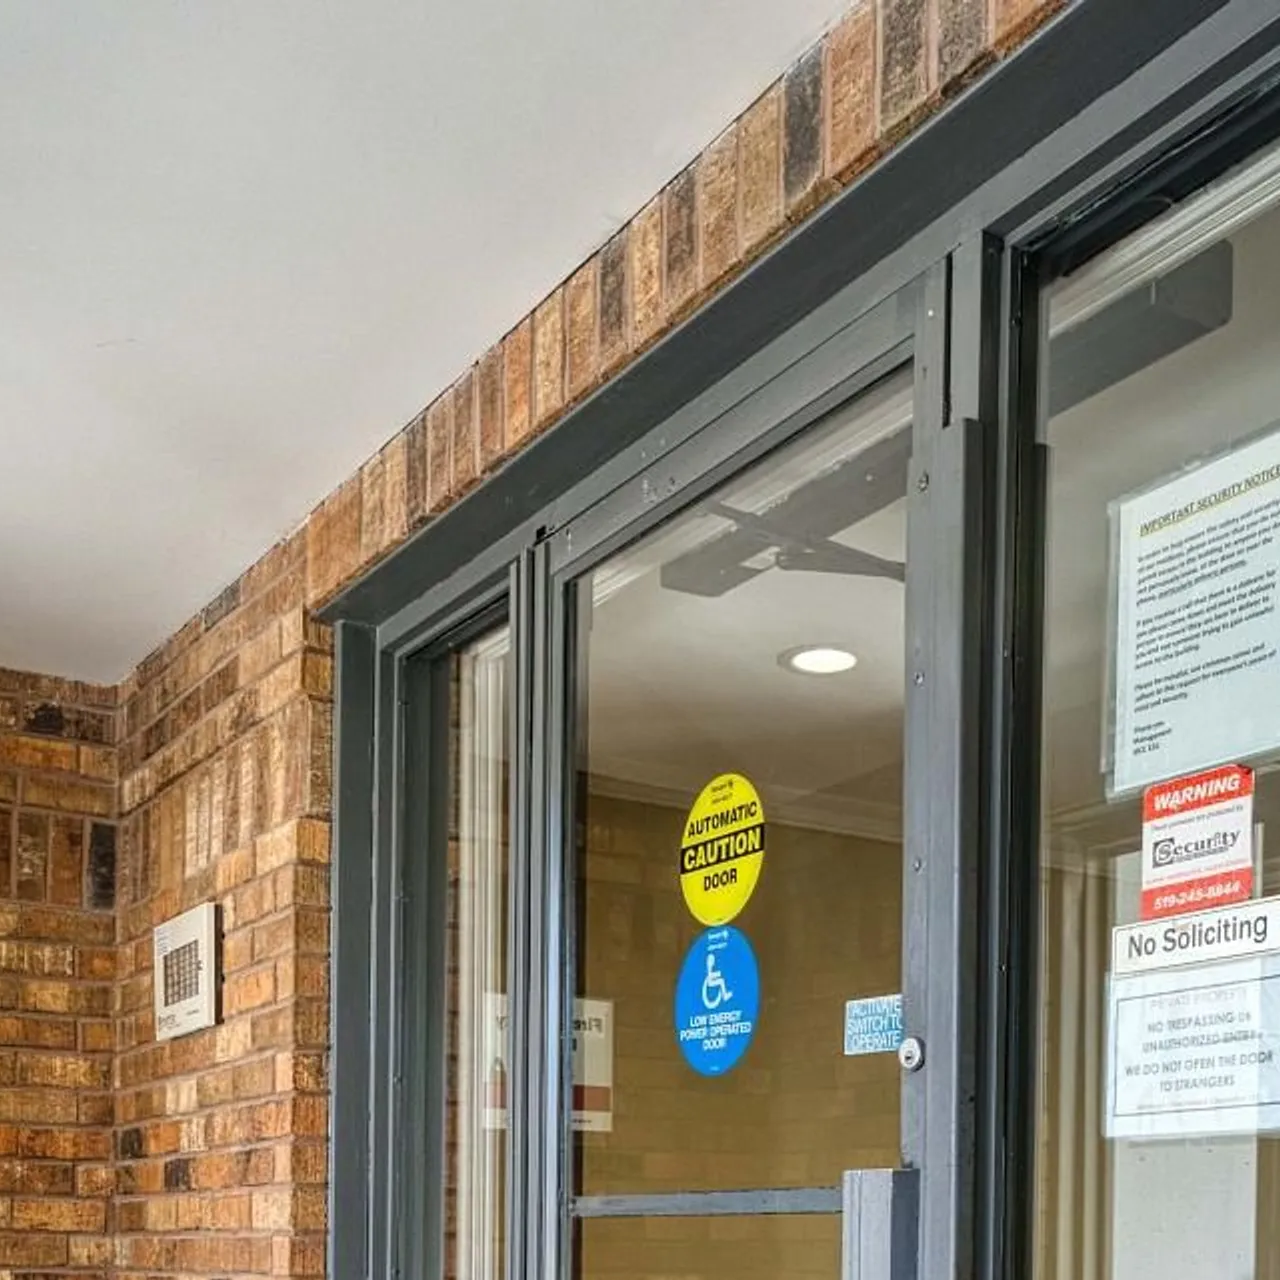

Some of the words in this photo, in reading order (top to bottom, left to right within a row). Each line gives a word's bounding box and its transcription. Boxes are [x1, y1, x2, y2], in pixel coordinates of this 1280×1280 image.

[1139, 502, 1195, 537] IMPORTANT
[1197, 483, 1243, 511] SECURITY
[1153, 773, 1240, 811] WARNING
[688, 801, 757, 838] AUTOMATIC
[684, 827, 761, 870] CAUTION
[1153, 830, 1241, 868] Security
[703, 868, 737, 891] DOOR
[1128, 935, 1156, 958] No
[1162, 915, 1268, 953] Soliciting
